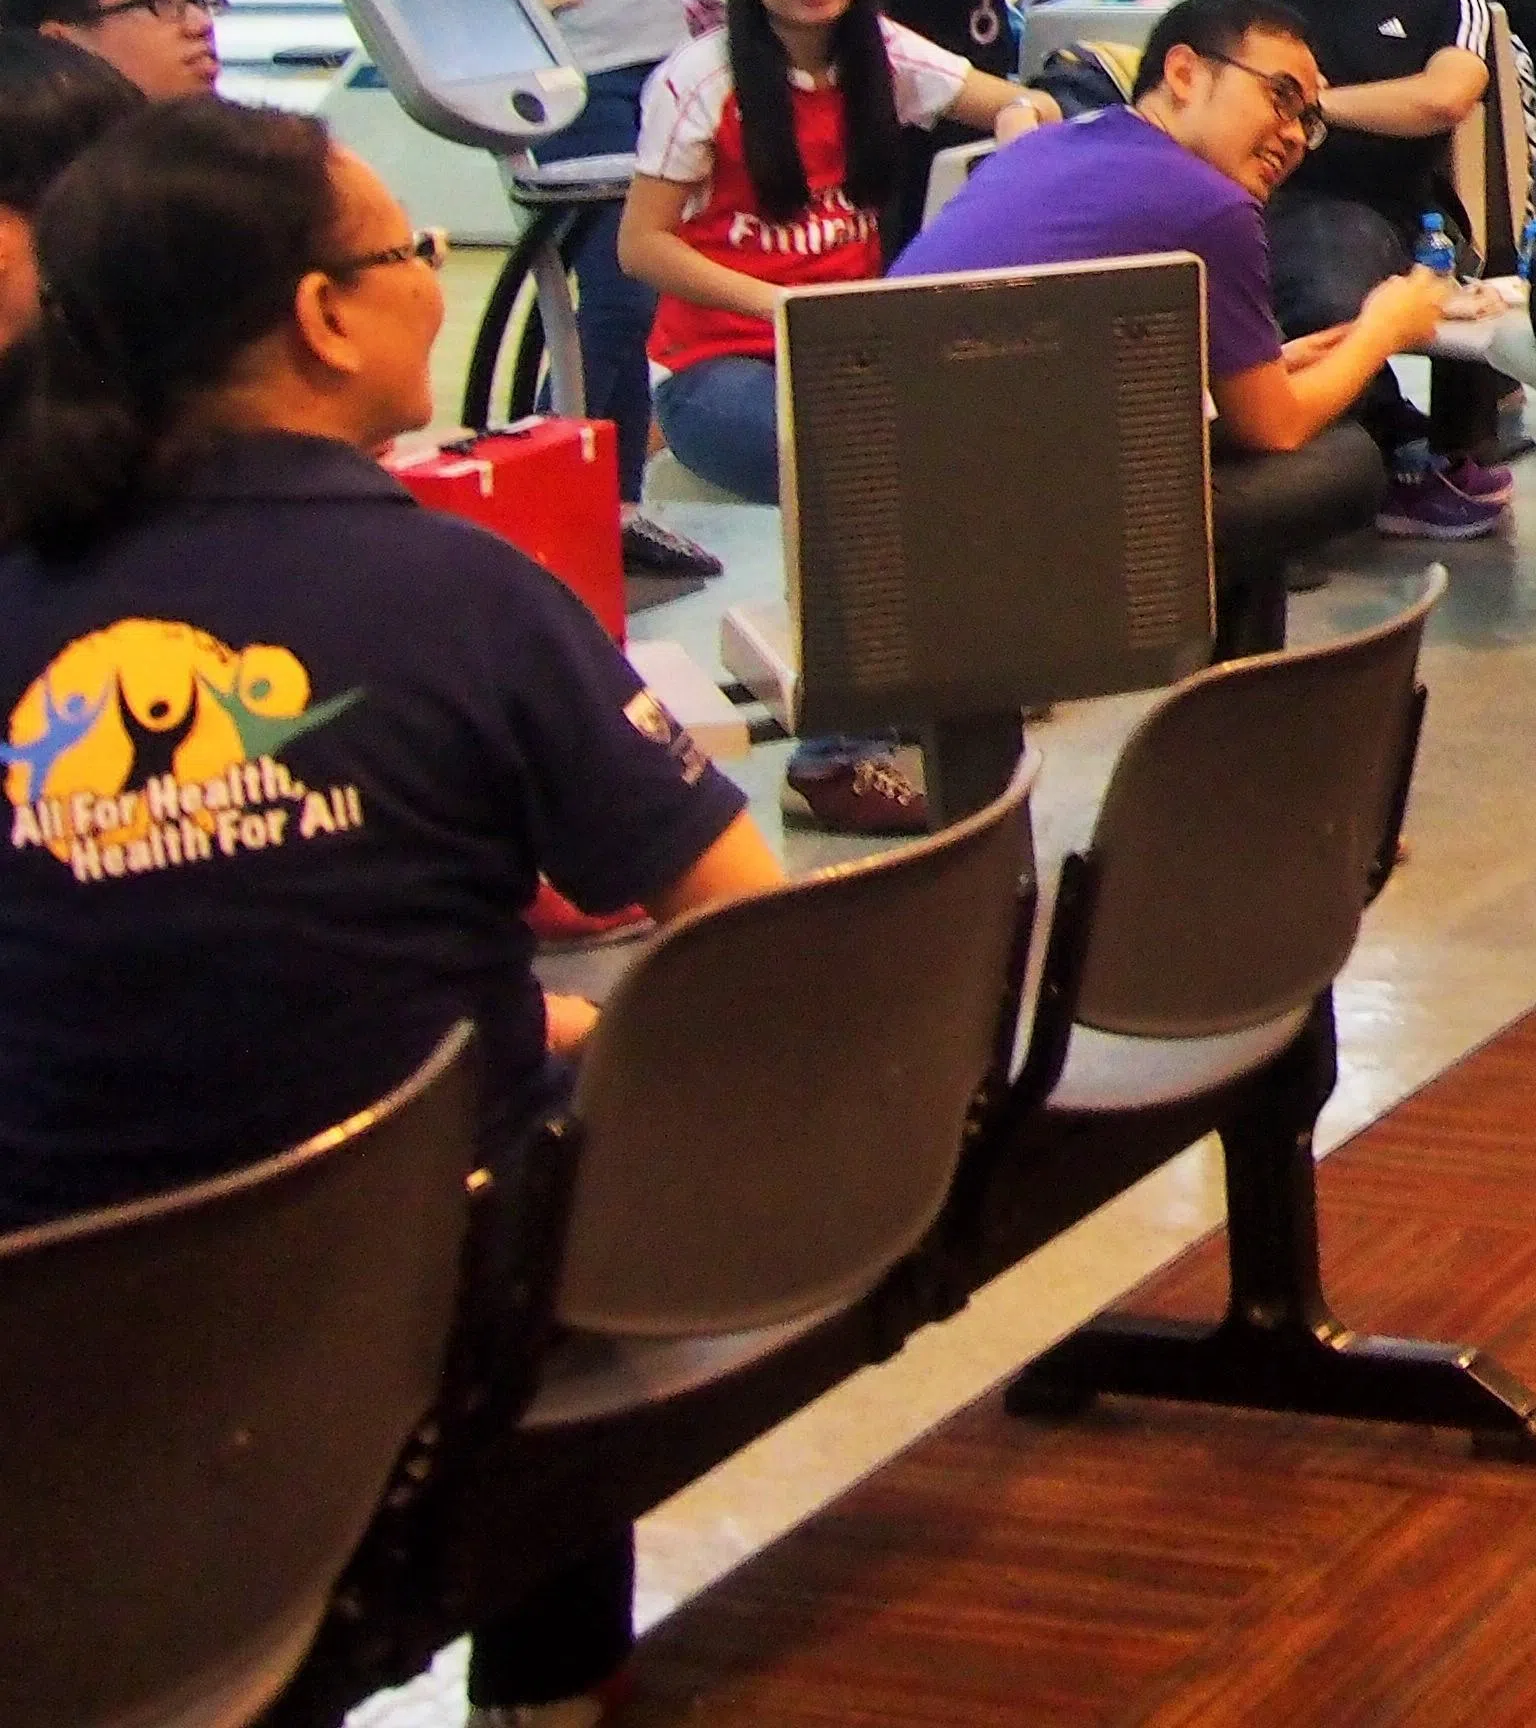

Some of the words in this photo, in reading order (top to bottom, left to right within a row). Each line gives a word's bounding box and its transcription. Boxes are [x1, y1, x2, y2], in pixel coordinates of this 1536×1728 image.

[10, 797, 64, 849] All
[71, 790, 140, 835] For
[71, 817, 213, 884] Health
[215, 807, 289, 857] For
[300, 784, 365, 839] All
